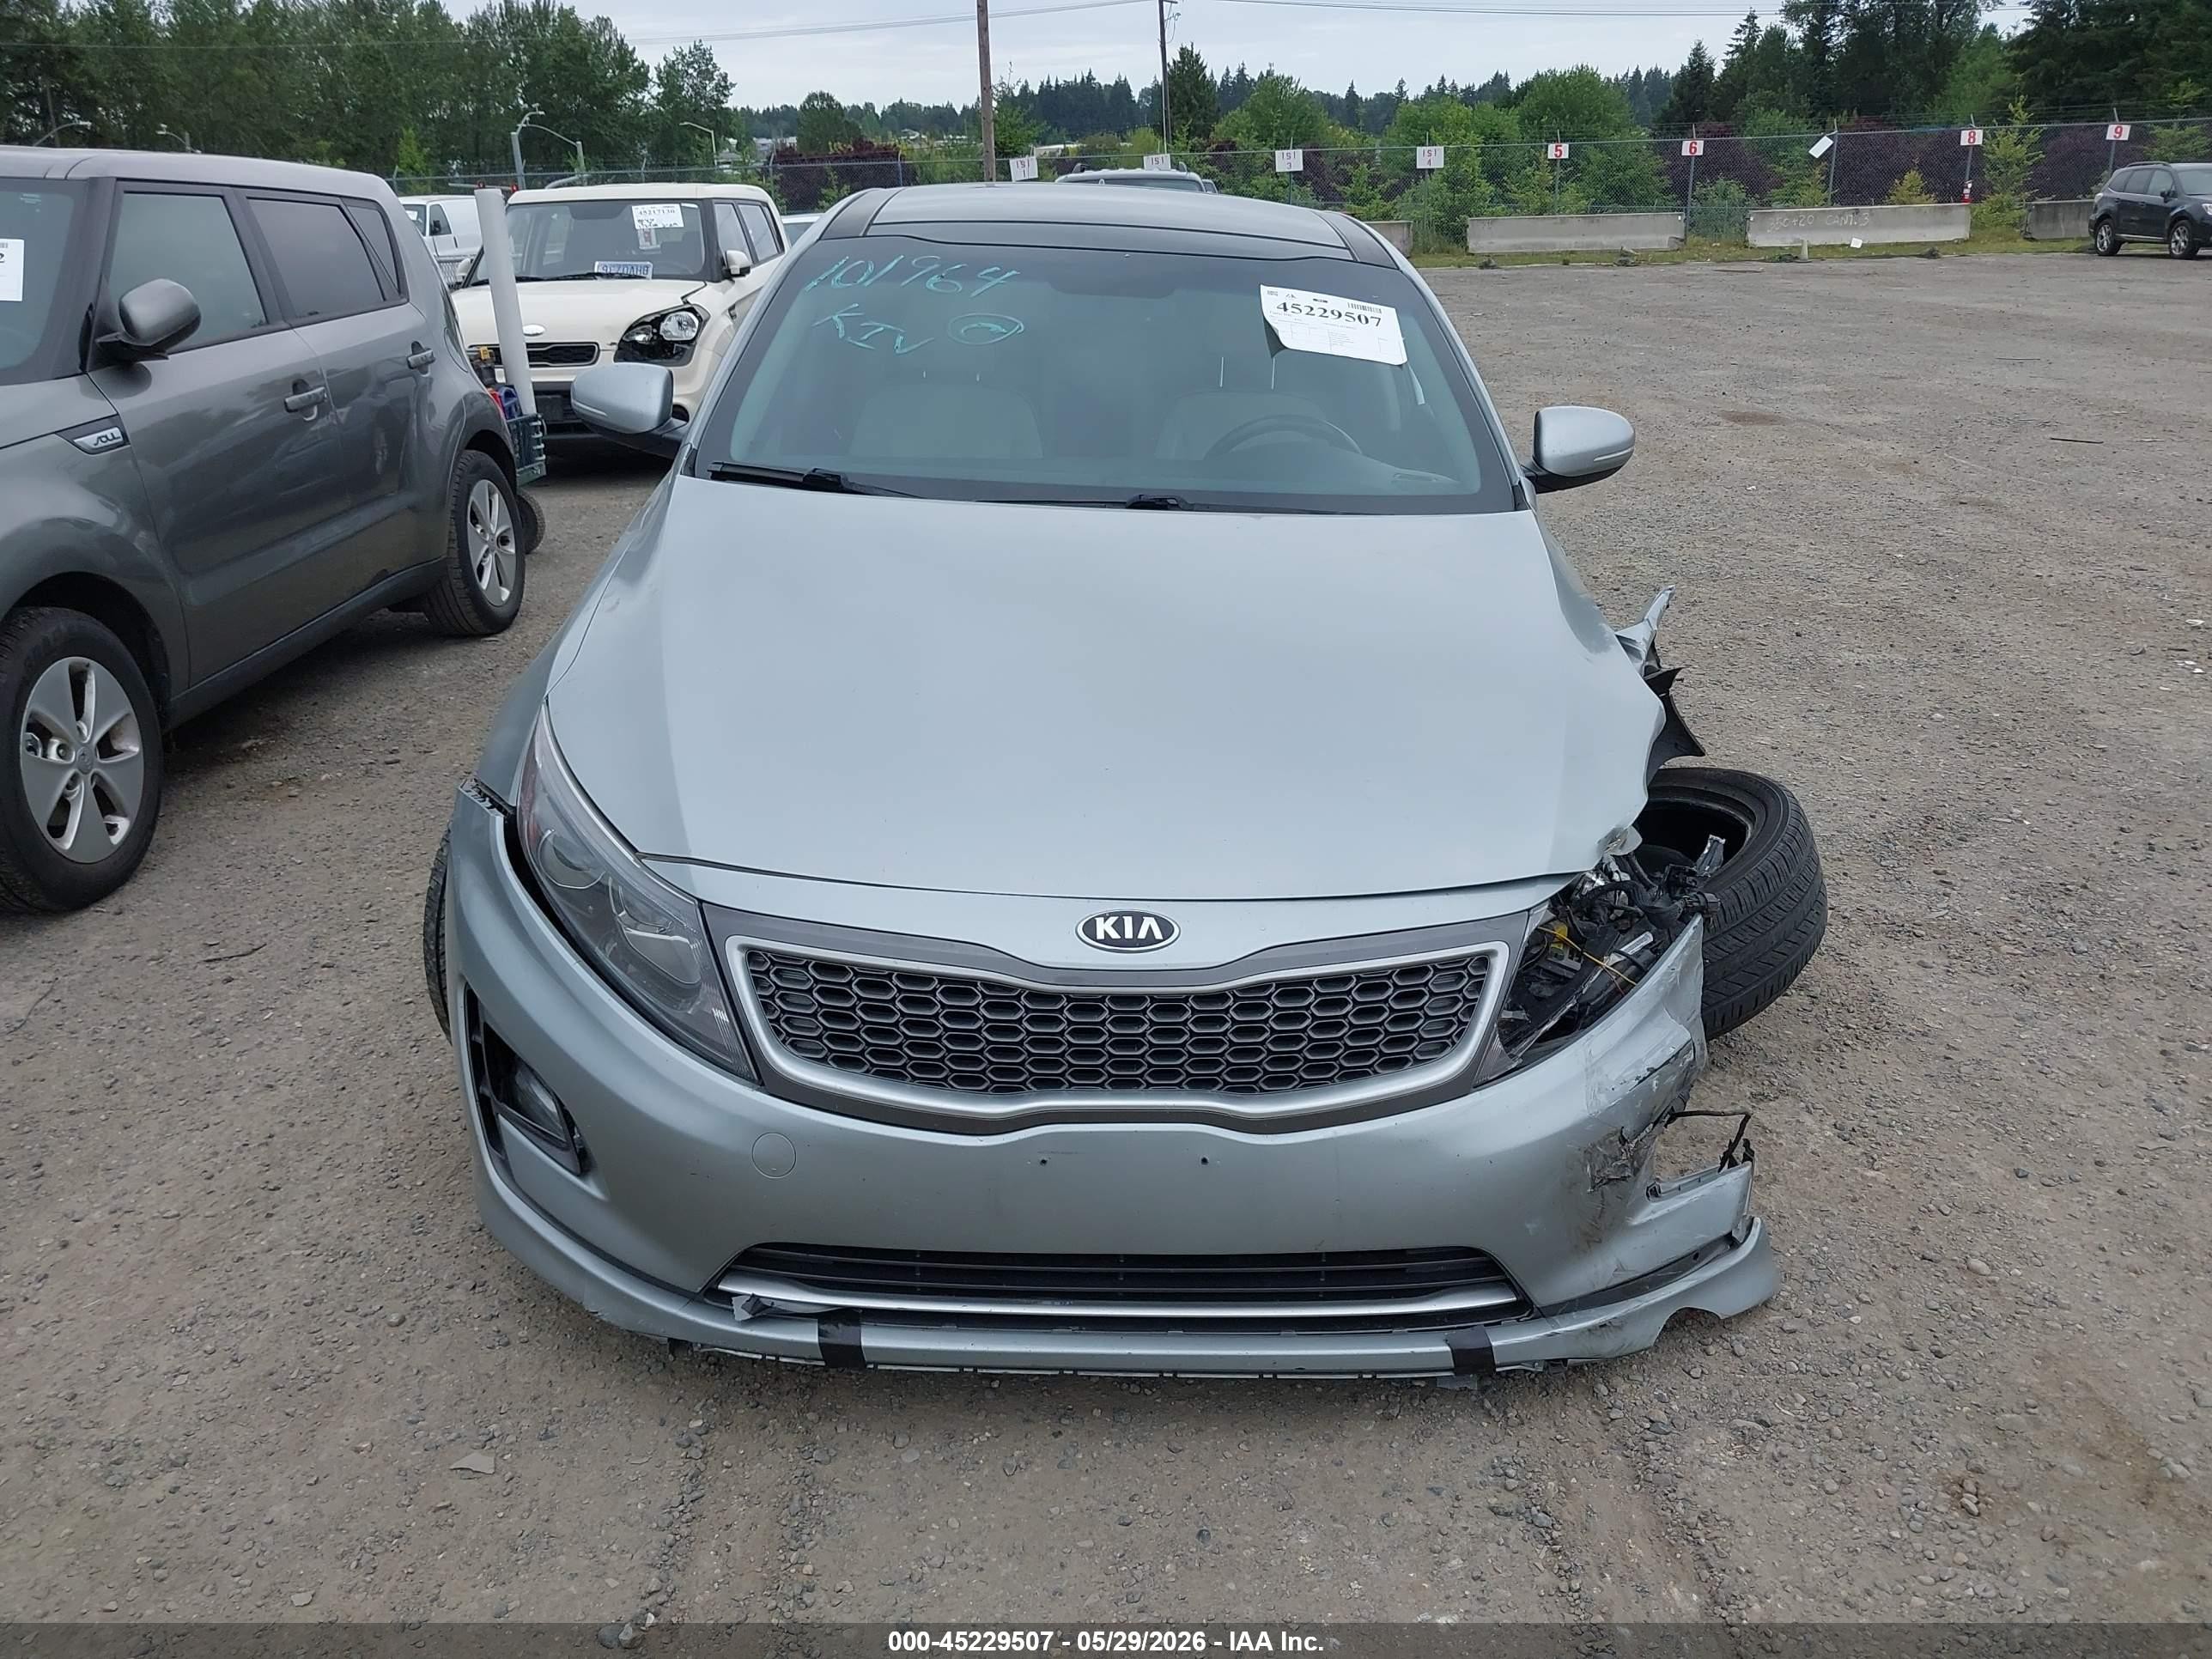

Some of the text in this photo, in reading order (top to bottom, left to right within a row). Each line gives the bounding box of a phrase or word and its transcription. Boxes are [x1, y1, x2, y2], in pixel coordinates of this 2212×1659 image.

[1967, 131, 1977, 144] 8
[2113, 126, 2123, 139] 9
[1553, 144, 1563, 158] 5
[1688, 141, 1698, 155] 6
[1275, 301, 1382, 327] 45229507
[1094, 915, 1164, 940] KIA
